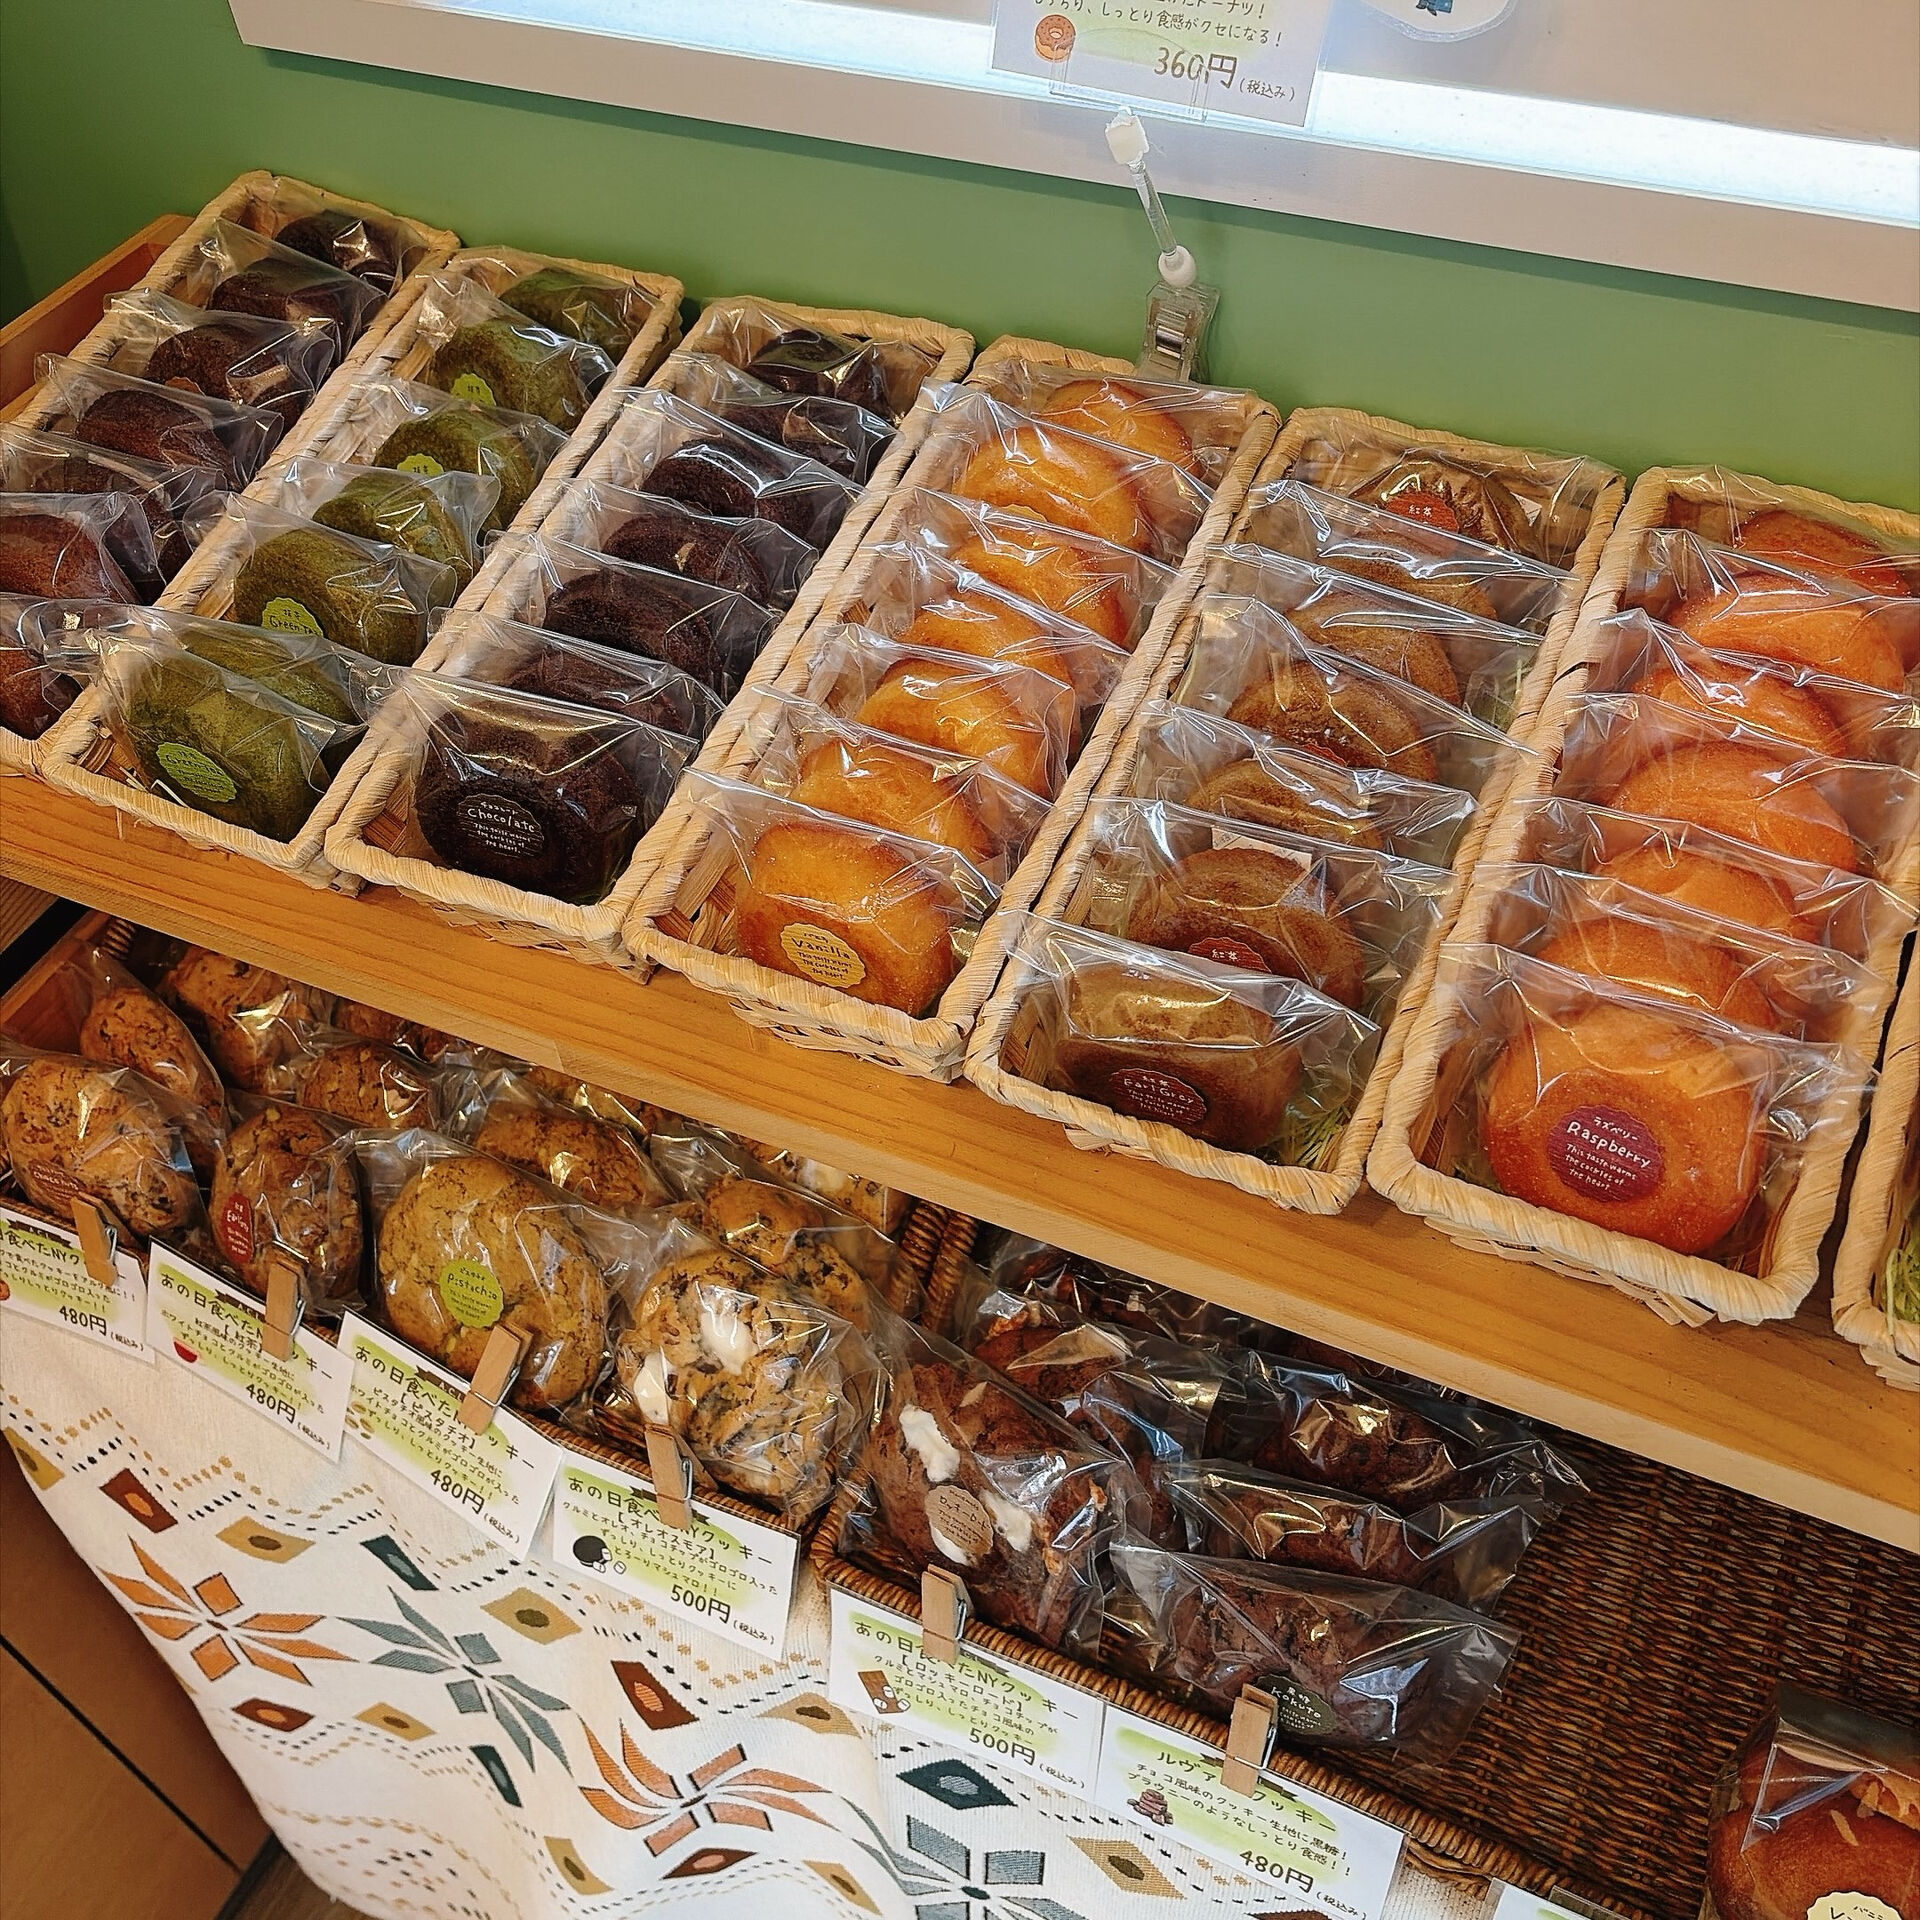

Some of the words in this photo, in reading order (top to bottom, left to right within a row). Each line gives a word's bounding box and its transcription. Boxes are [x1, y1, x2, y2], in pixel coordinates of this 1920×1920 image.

[1153, 46, 1238, 89] 360円
[1239, 78, 1295, 102] (税込み)
[467, 808, 536, 834] Chocolate
[790, 937, 851, 960] Vanilla
[1211, 948, 1238, 961] 紅茶
[1123, 1078, 1156, 1092] Earl
[1159, 1087, 1194, 1104] Grey
[1566, 1121, 1651, 1168] Raspberry
[1594, 1116, 1639, 1141] ラズベリー
[1565, 1154, 1579, 1166] the
[1580, 1162, 1613, 1182] cockles
[1566, 1143, 1584, 1157] This
[1586, 1153, 1609, 1168] taste
[1609, 1164, 1637, 1180] warms
[1569, 1168, 1584, 1180] the
[59, 1305, 107, 1336] 480円
[246, 1383, 296, 1424] 480円
[400, 1392, 476, 1450] 【ピスタチオ】
[430, 1469, 485, 1515] 480円
[483, 1512, 520, 1544] (税込み)
[618, 1511, 715, 1560] 【オレオスモア】
[670, 1583, 731, 1624] 500円
[733, 1618, 775, 1645] (税込み)
[901, 1653, 1022, 1712] 【ロッキーロード】
[969, 1727, 1036, 1766] 500円
[1039, 1763, 1085, 1789] (税込み)
[1156, 1752, 1336, 1832] ルヴァクッキー
[1239, 1850, 1314, 1894] 480円
